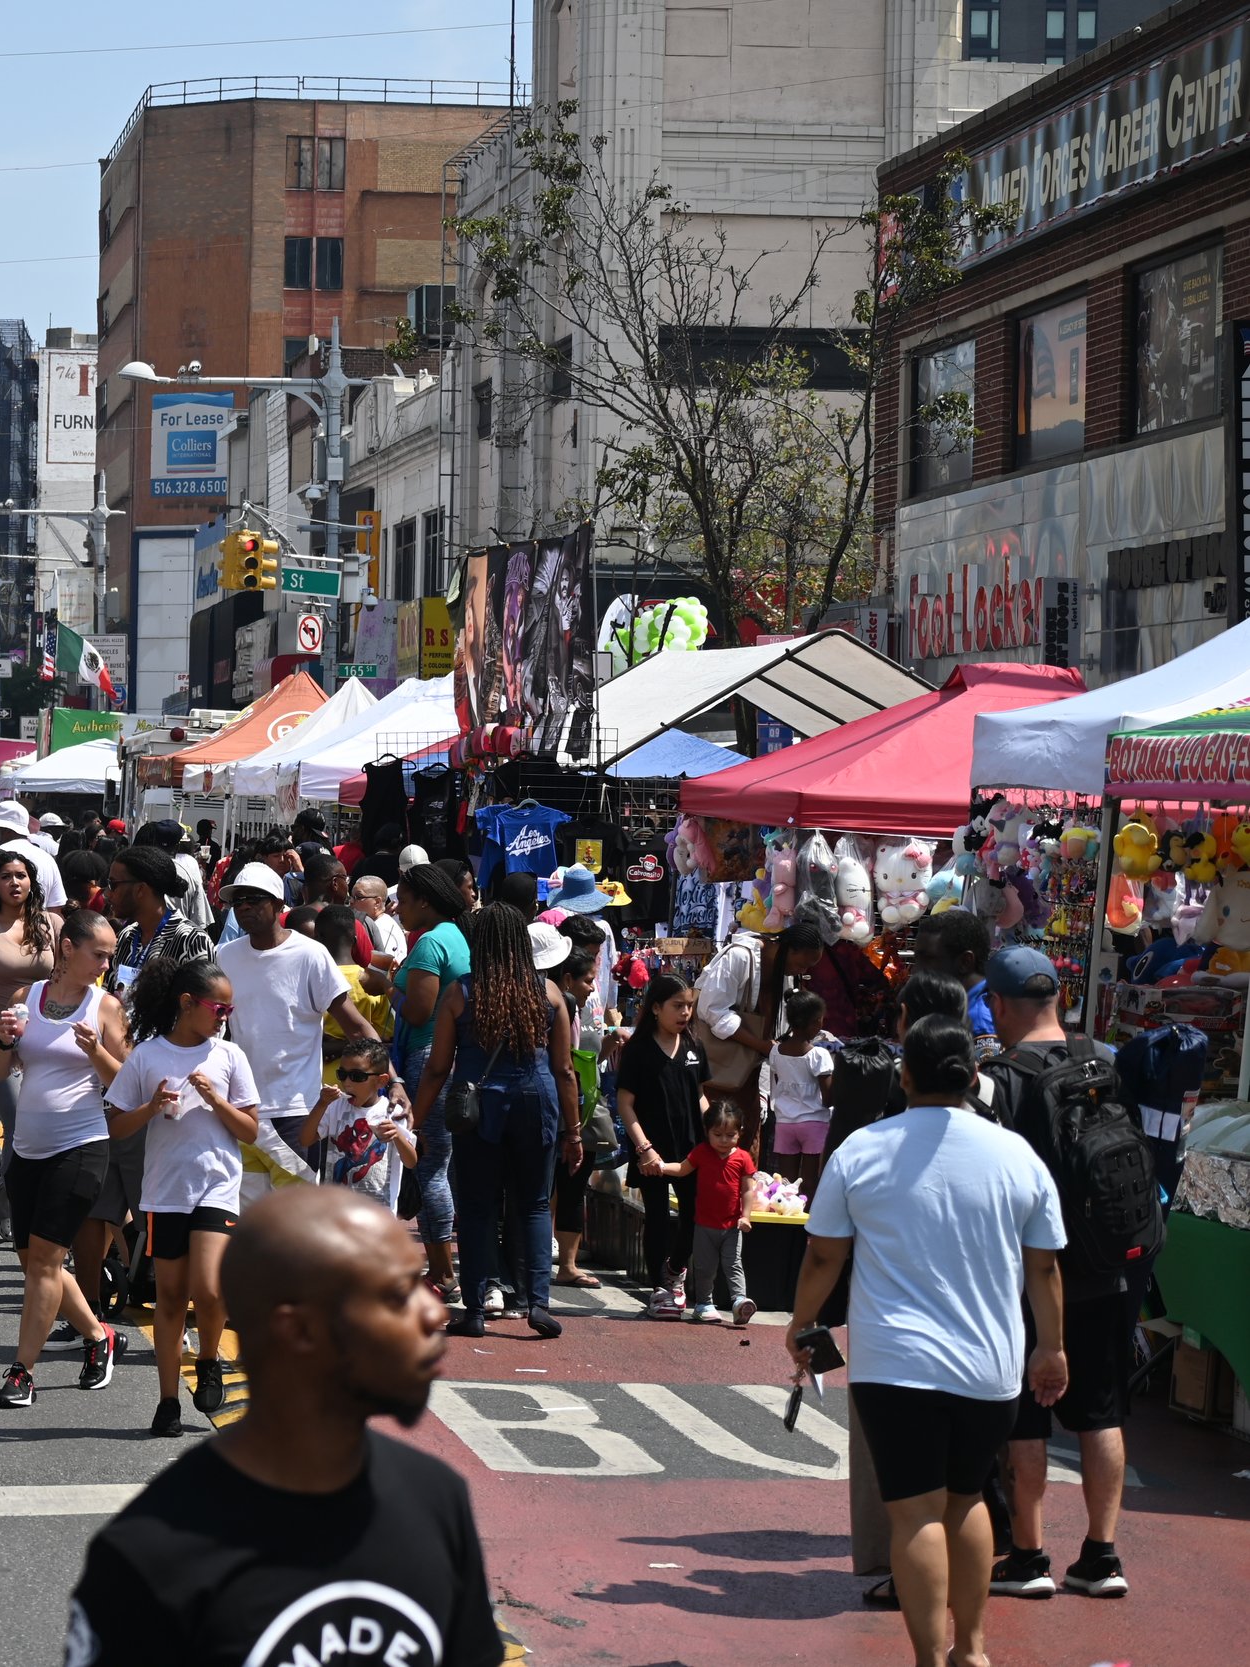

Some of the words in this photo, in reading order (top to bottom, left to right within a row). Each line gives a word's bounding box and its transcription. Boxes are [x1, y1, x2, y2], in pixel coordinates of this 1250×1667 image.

[1032, 132, 1090, 211] FORCES
[1095, 98, 1160, 181] CAREER
[1166, 59, 1241, 148] CENTER
[55, 365, 76, 380] The
[54, 414, 95, 430] FURN
[161, 413, 182, 427] For
[186, 412, 224, 425] Lease
[171, 438, 212, 451] Colliers
[154, 479, 227, 495] 516.328.6500
[290, 573, 304, 588] St
[962, 556, 1044, 652] Locker
[866, 611, 878, 649] ocker
[344, 666, 364, 676] 165
[72, 720, 123, 733] Authentic
[1109, 736, 1183, 783] BOTANAS
[1179, 733, 1239, 783] LOCAS
[519, 825, 537, 840] Los
[506, 834, 551, 856] Angeles
[629, 869, 663, 879] Cabronsito
[429, 1380, 849, 1480] BU
[278, 1616, 421, 1667] MADE
